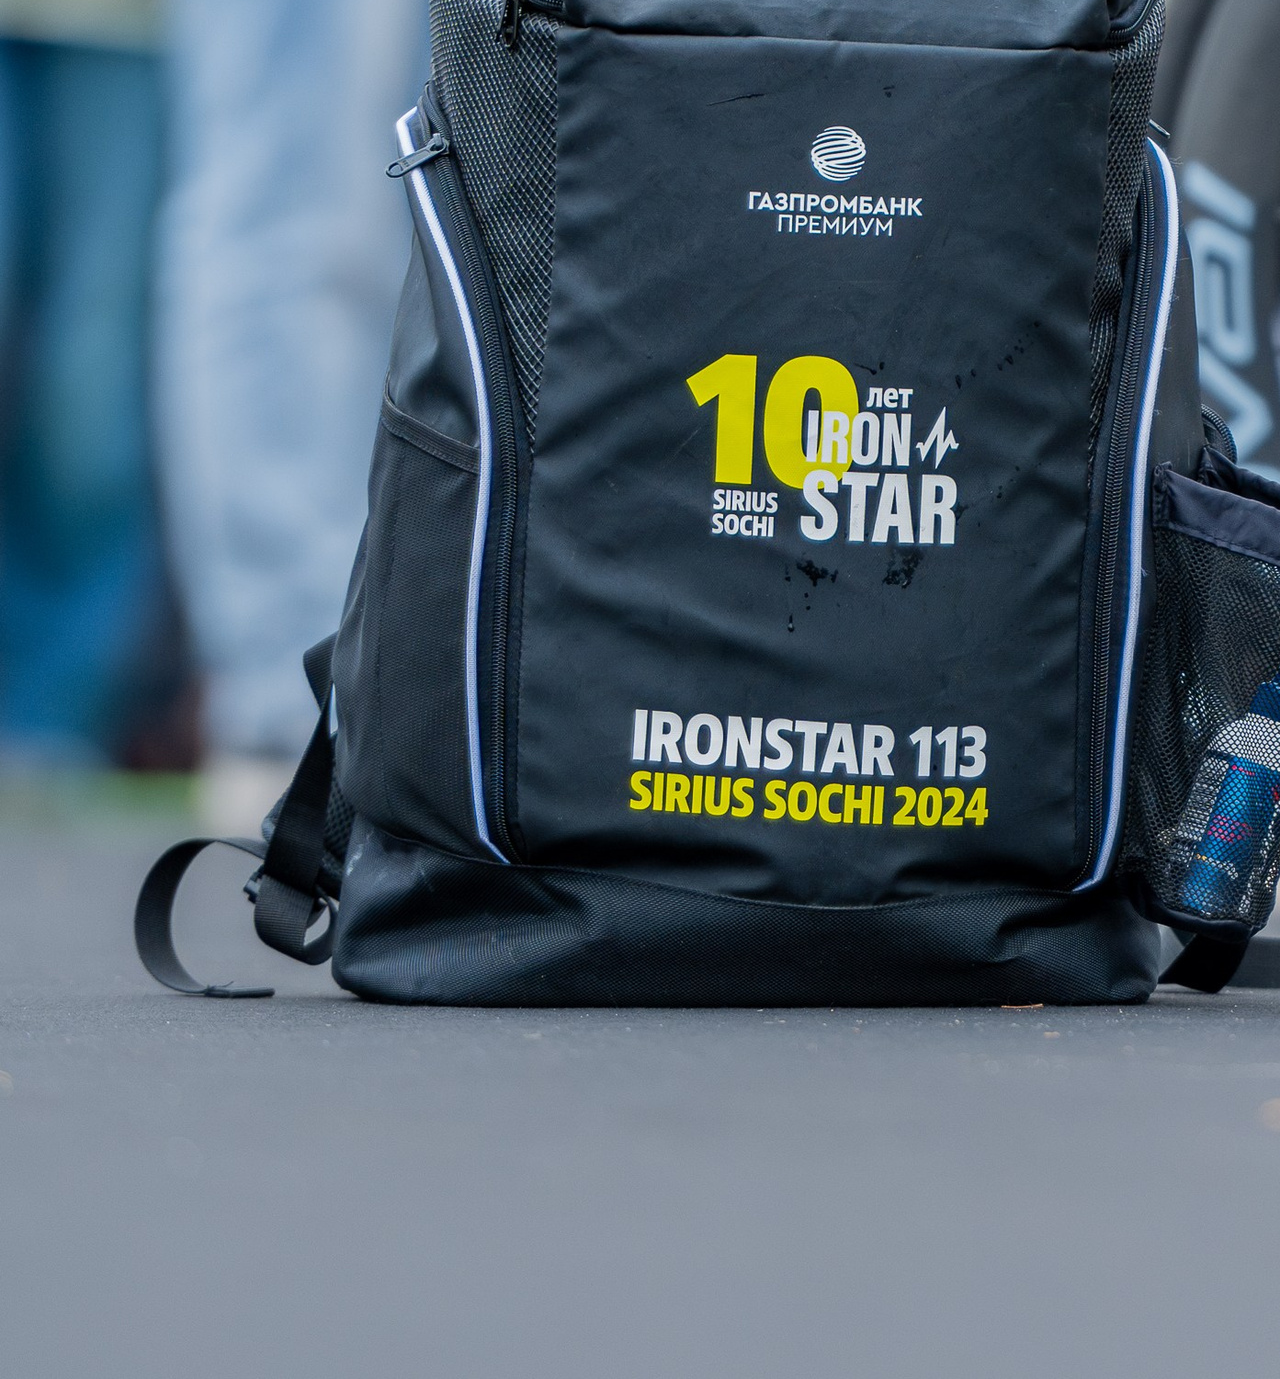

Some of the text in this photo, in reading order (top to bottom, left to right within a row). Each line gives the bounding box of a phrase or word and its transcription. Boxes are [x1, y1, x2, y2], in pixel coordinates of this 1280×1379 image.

[748, 191, 923, 217] ГАЗПРОМБАНК
[777, 214, 893, 237] ПРЕМИУМ
[866, 386, 914, 409] лет
[686, 353, 859, 490] 10
[805, 409, 912, 467] IRON
[713, 488, 778, 514] SIRIUS
[800, 469, 957, 545] STAR
[711, 512, 775, 538] SOCHI
[632, 709, 987, 778] IRONSTAR 113
[629, 770, 989, 827] SIRIUS SOCHI 2024
